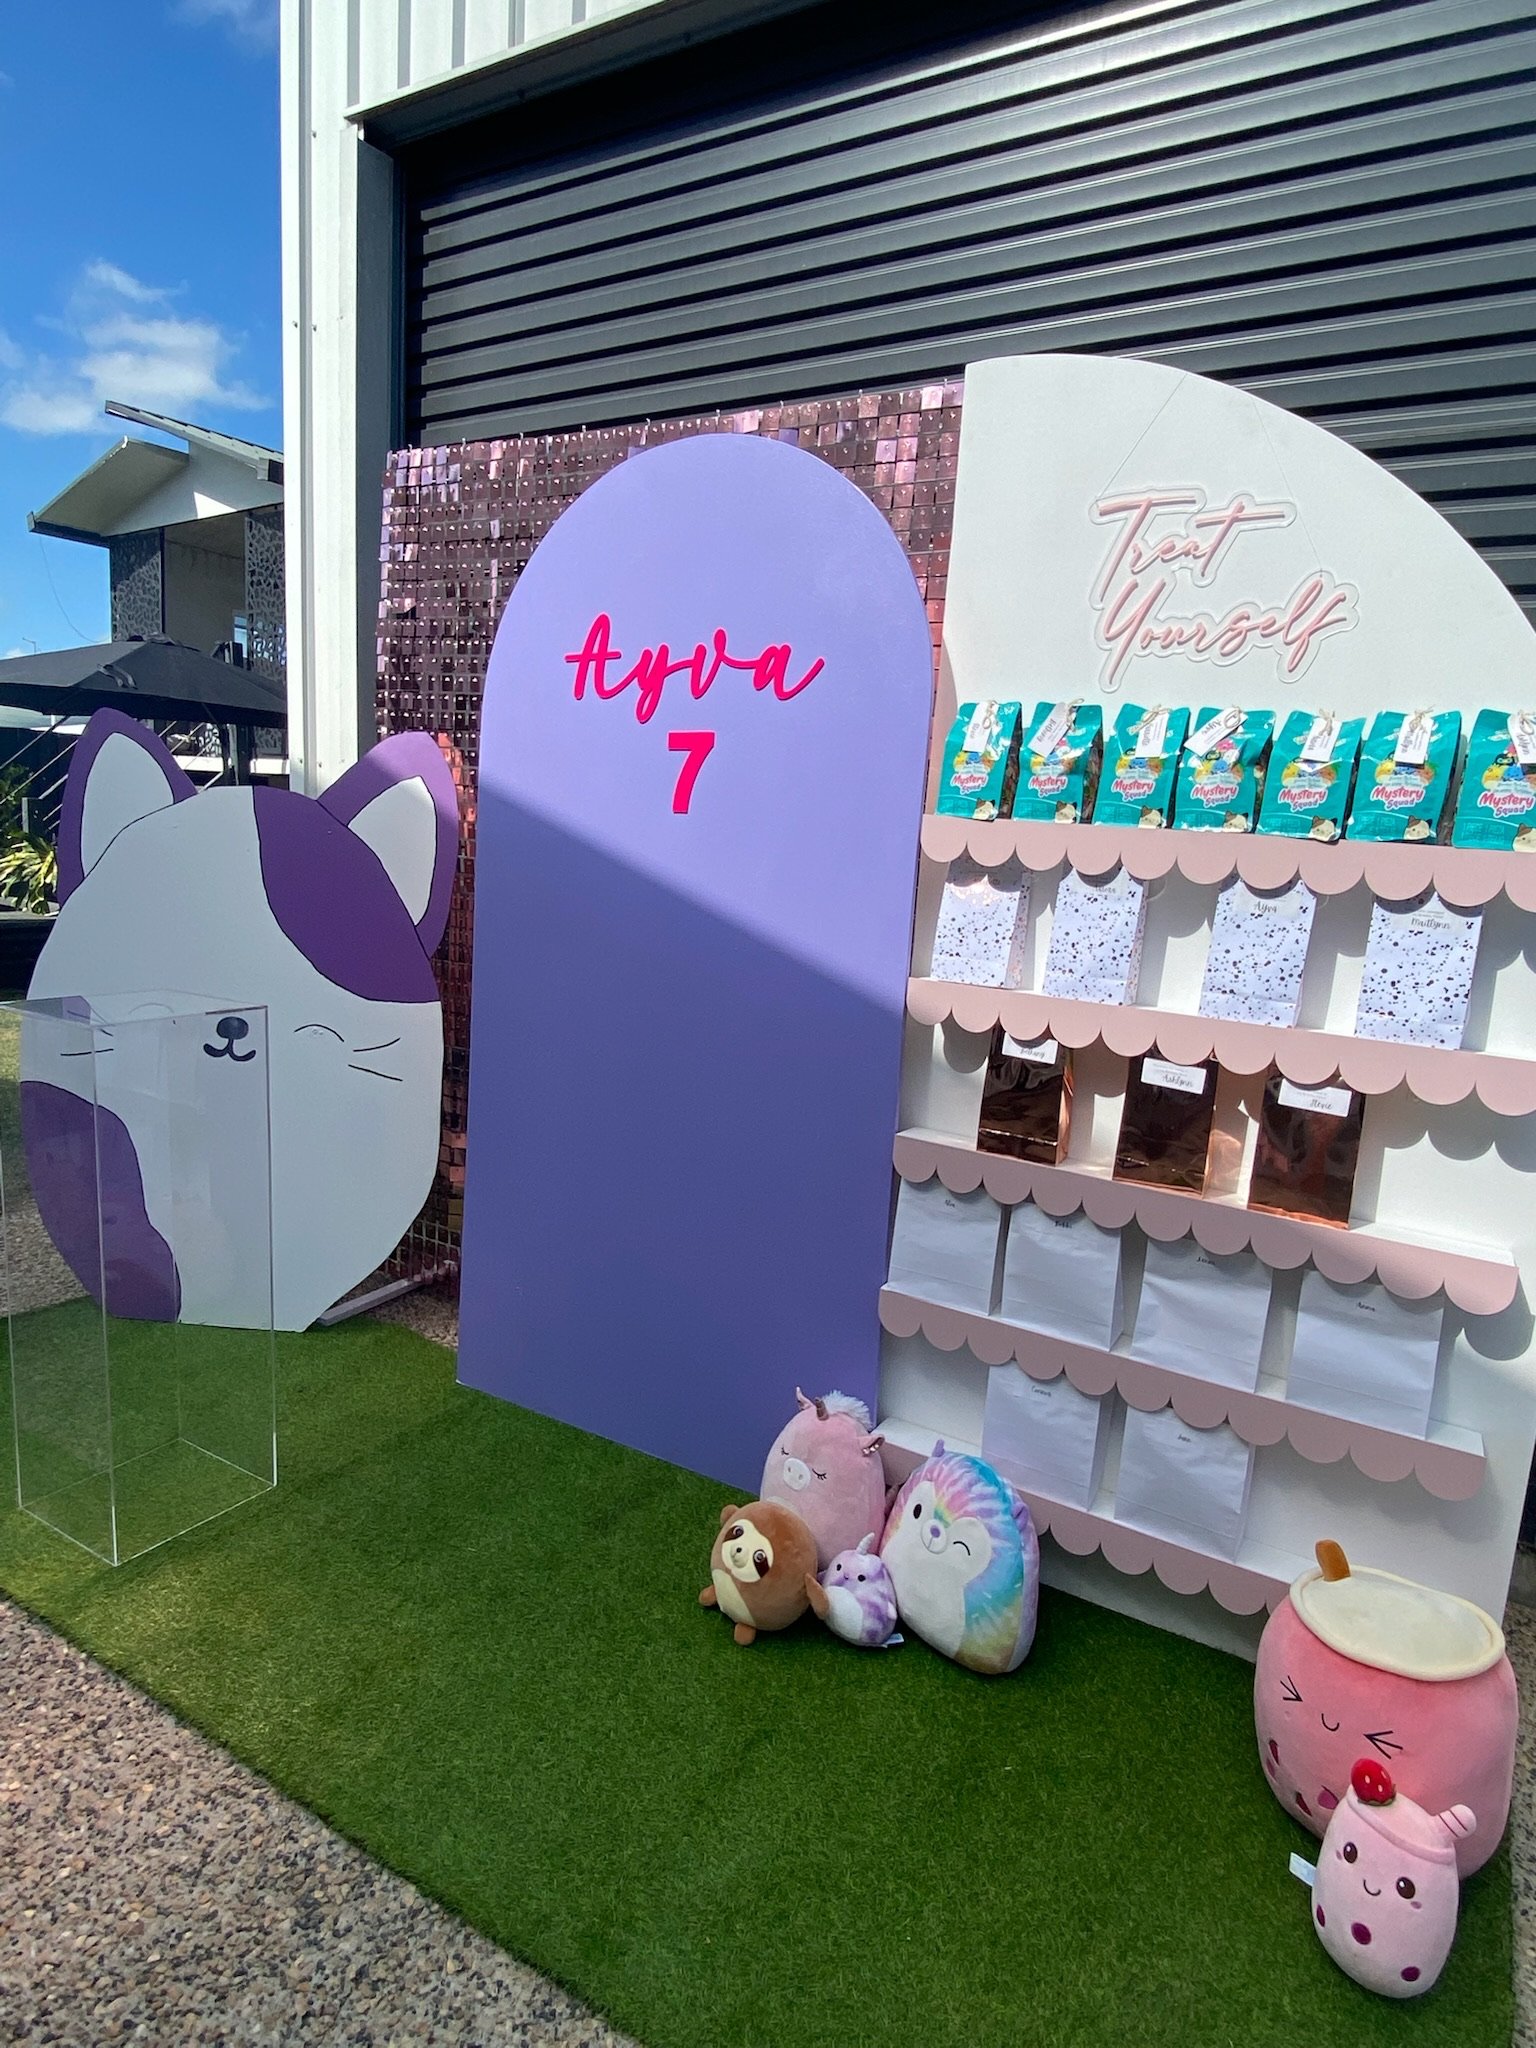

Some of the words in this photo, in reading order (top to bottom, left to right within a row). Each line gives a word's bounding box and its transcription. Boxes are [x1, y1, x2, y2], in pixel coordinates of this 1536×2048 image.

[1099, 495, 1286, 602] Treat
[1104, 578, 1347, 686] Yourself
[564, 612, 826, 724] Ayva
[667, 731, 716, 815] 7
[952, 773, 987, 786] Mystery
[1030, 776, 1067, 789] Mystery
[1113, 779, 1154, 793] Mystery
[1193, 784, 1239, 799] Mystery
[1279, 787, 1327, 802] Mystery
[1372, 786, 1424, 800] Mystery
[1479, 793, 1534, 808] Mystery
